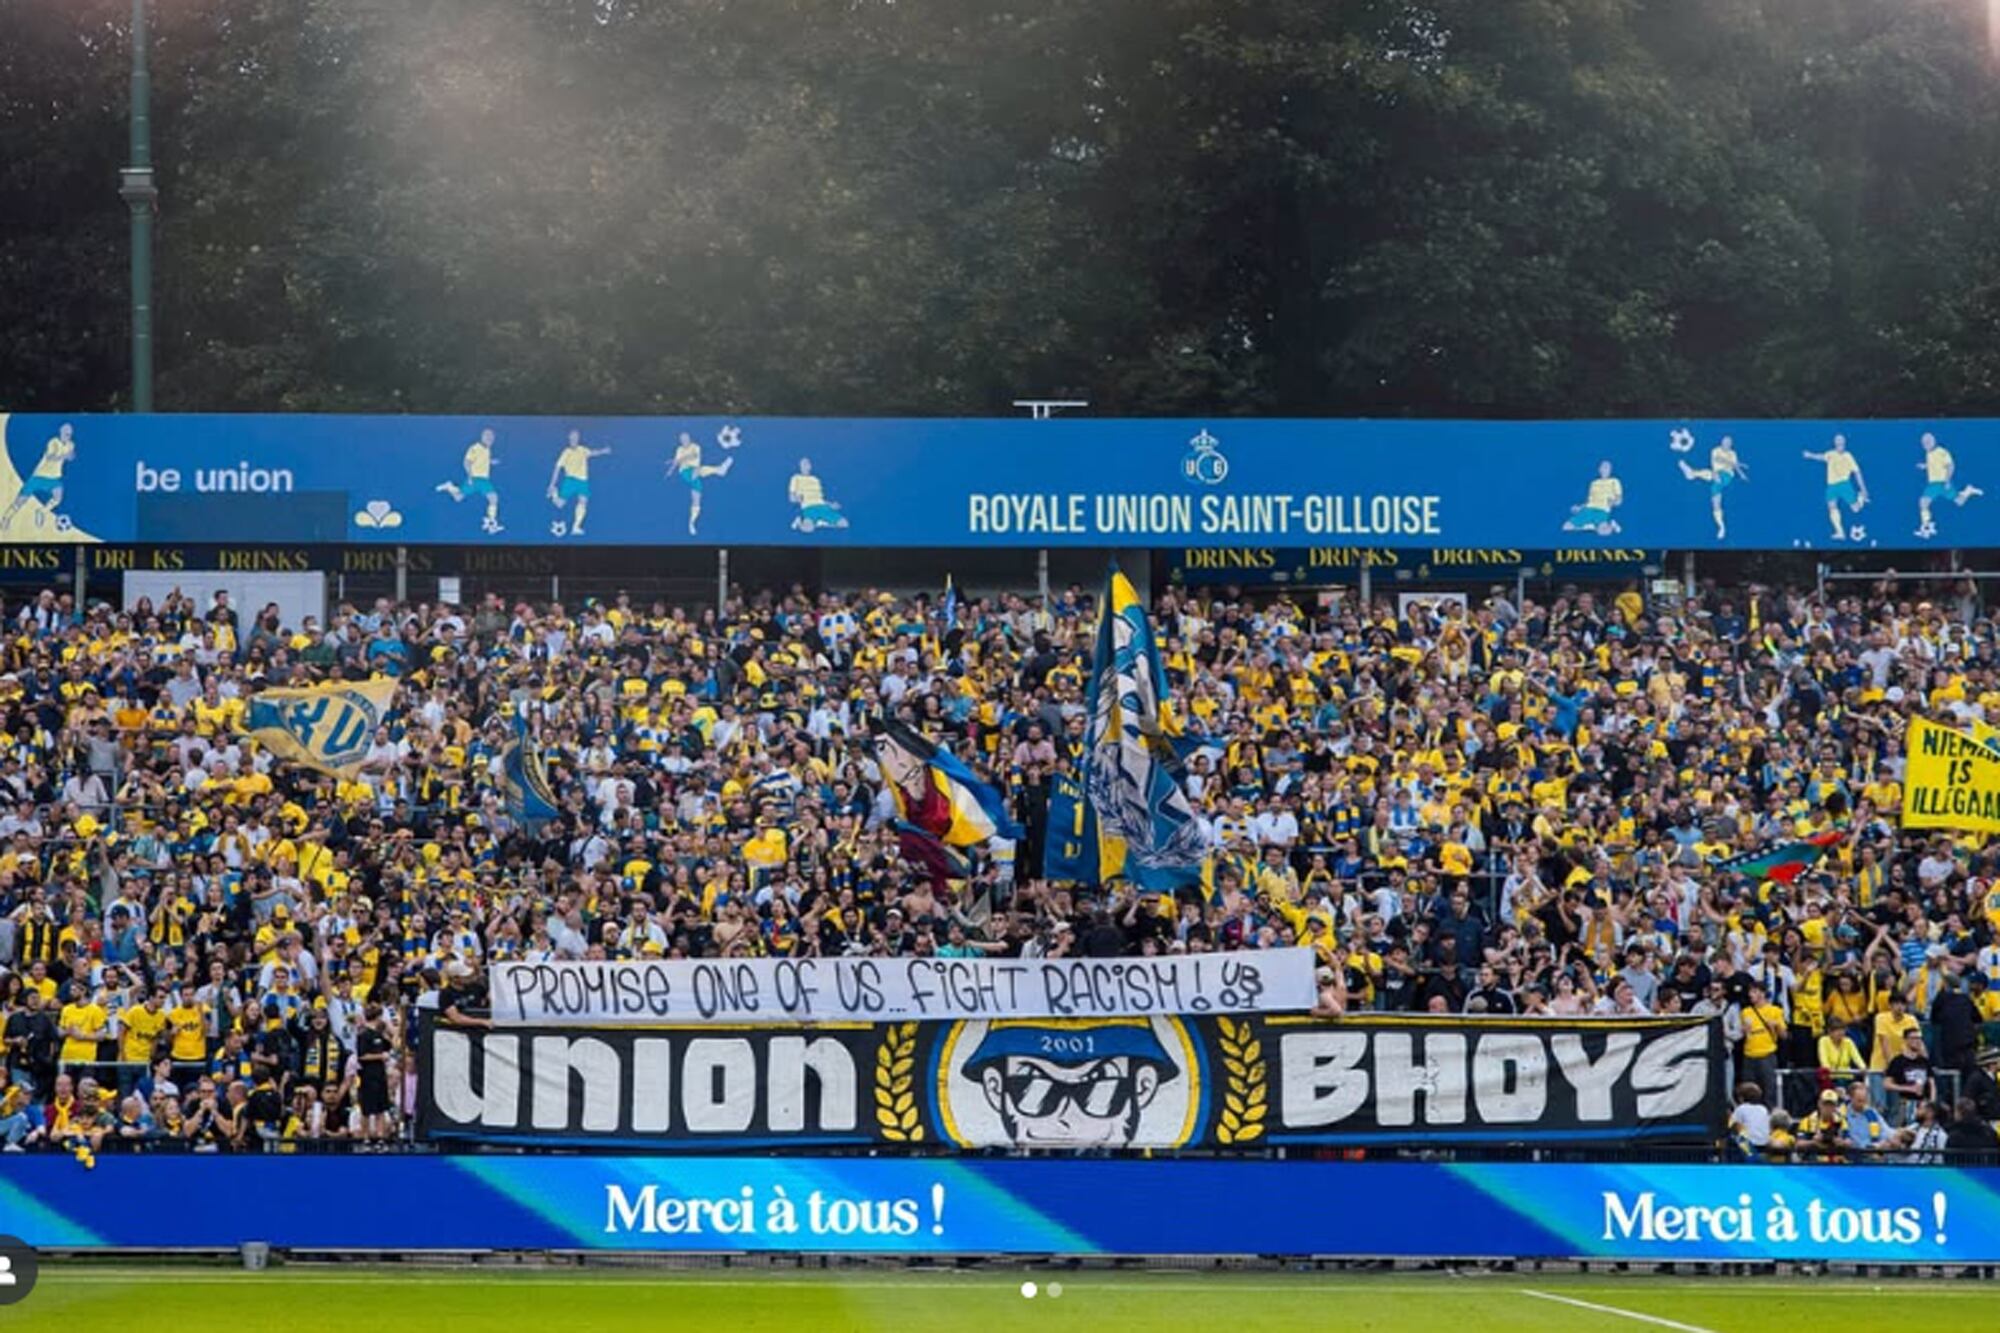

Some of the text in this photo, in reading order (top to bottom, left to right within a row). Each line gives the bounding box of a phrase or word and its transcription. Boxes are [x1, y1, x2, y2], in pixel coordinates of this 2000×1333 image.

[136, 461, 293, 492] be union
[969, 495, 1441, 534] ROYALE UNION SAINT-GILLOISE
[0, 549, 60, 569] INKS
[218, 549, 309, 569] DRINKS
[1185, 548, 1276, 568] DRINKS
[1432, 549, 1522, 565] DRINKS
[1948, 760, 1972, 786] IS
[774, 959, 819, 1012] OF
[1040, 1036, 1094, 1054] 2001
[1280, 1025, 1709, 1127] BHOYS
[604, 1184, 754, 1234] Merci
[767, 1185, 798, 1234] à
[807, 1190, 919, 1235] tous
[1602, 1191, 1754, 1242] Merci
[1766, 1193, 1798, 1242] à
[1806, 1198, 1921, 1243] tous
